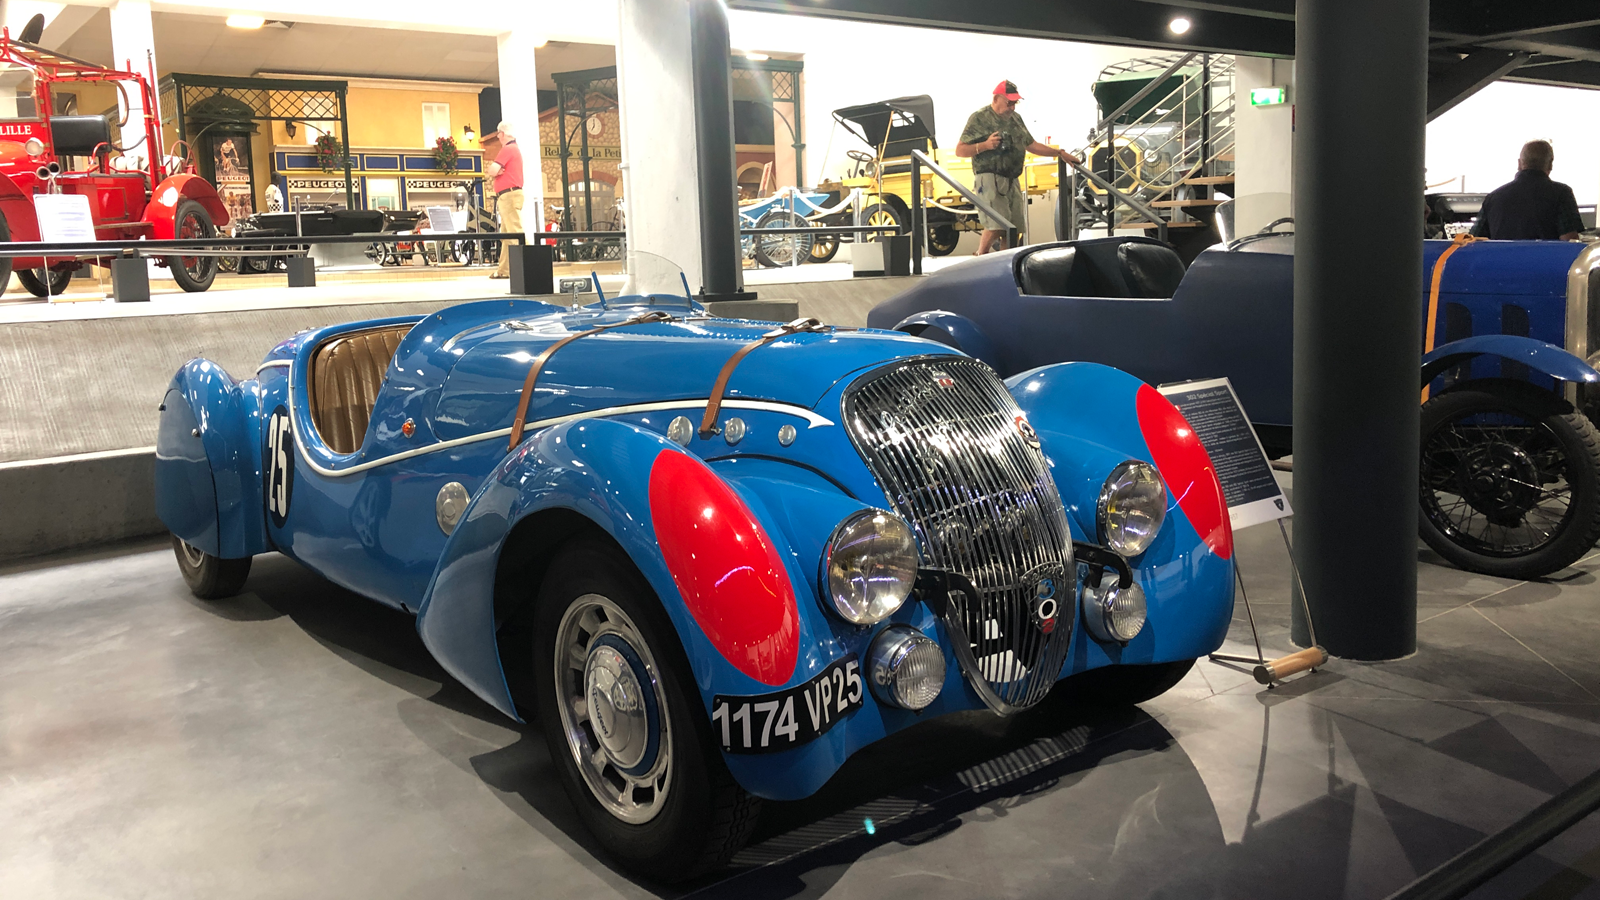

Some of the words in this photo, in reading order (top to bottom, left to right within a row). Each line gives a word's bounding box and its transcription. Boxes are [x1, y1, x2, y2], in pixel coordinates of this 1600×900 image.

[0, 125, 32, 135] LILLE
[592, 147, 602, 157] la
[268, 413, 289, 518] 25
[1037, 578, 1057, 634] 302
[592, 687, 608, 735] Peugeot
[712, 696, 799, 748] 1174
[803, 659, 863, 732] VP25
